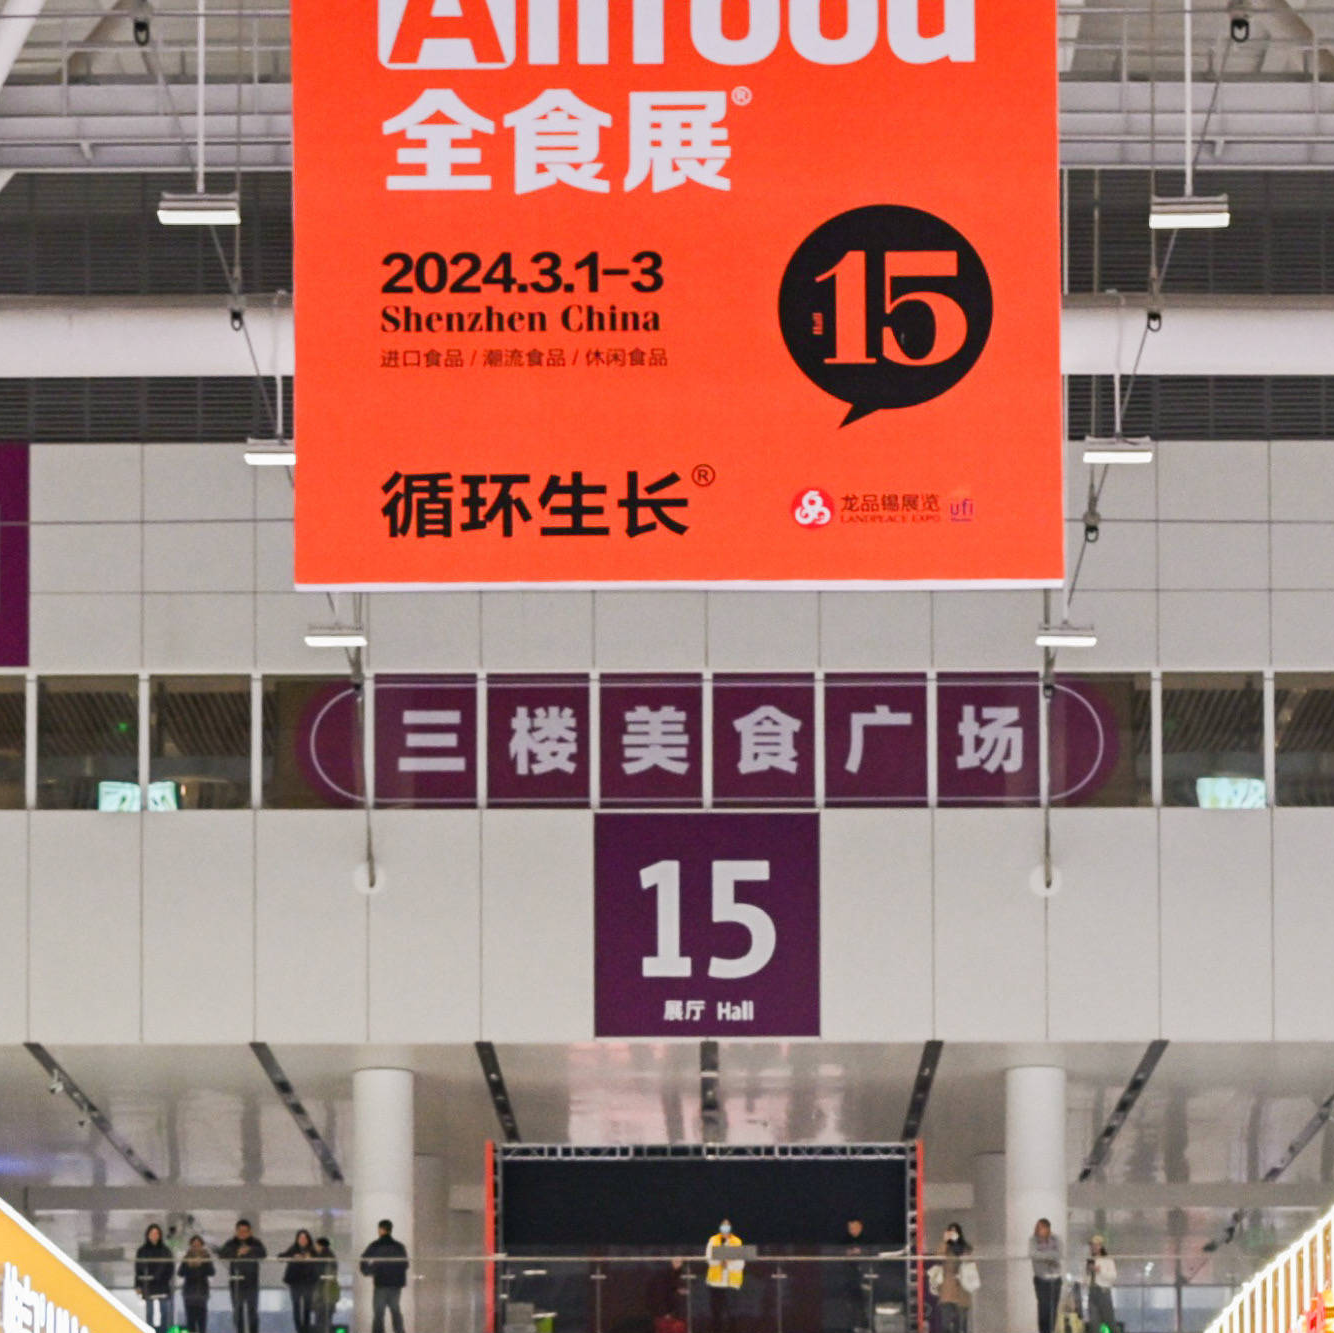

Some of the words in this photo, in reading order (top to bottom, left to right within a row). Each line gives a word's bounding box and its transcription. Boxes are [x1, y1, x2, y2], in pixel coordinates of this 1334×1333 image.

[382, 88, 731, 194] 全食展
[381, 251, 664, 294] 2024.3.1-3
[381, 305, 547, 333] Shenzhen
[561, 305, 661, 333] China
[815, 250, 968, 366] 15
[380, 349, 464, 368] 进口食品
[483, 349, 566, 367] 潮流食品
[585, 348, 668, 367] 休闲食品
[381, 470, 689, 538] 循环生长
[398, 705, 1025, 776] 三楼美食广场
[639, 860, 777, 980] 15
[717, 1001, 755, 1023] Hall
